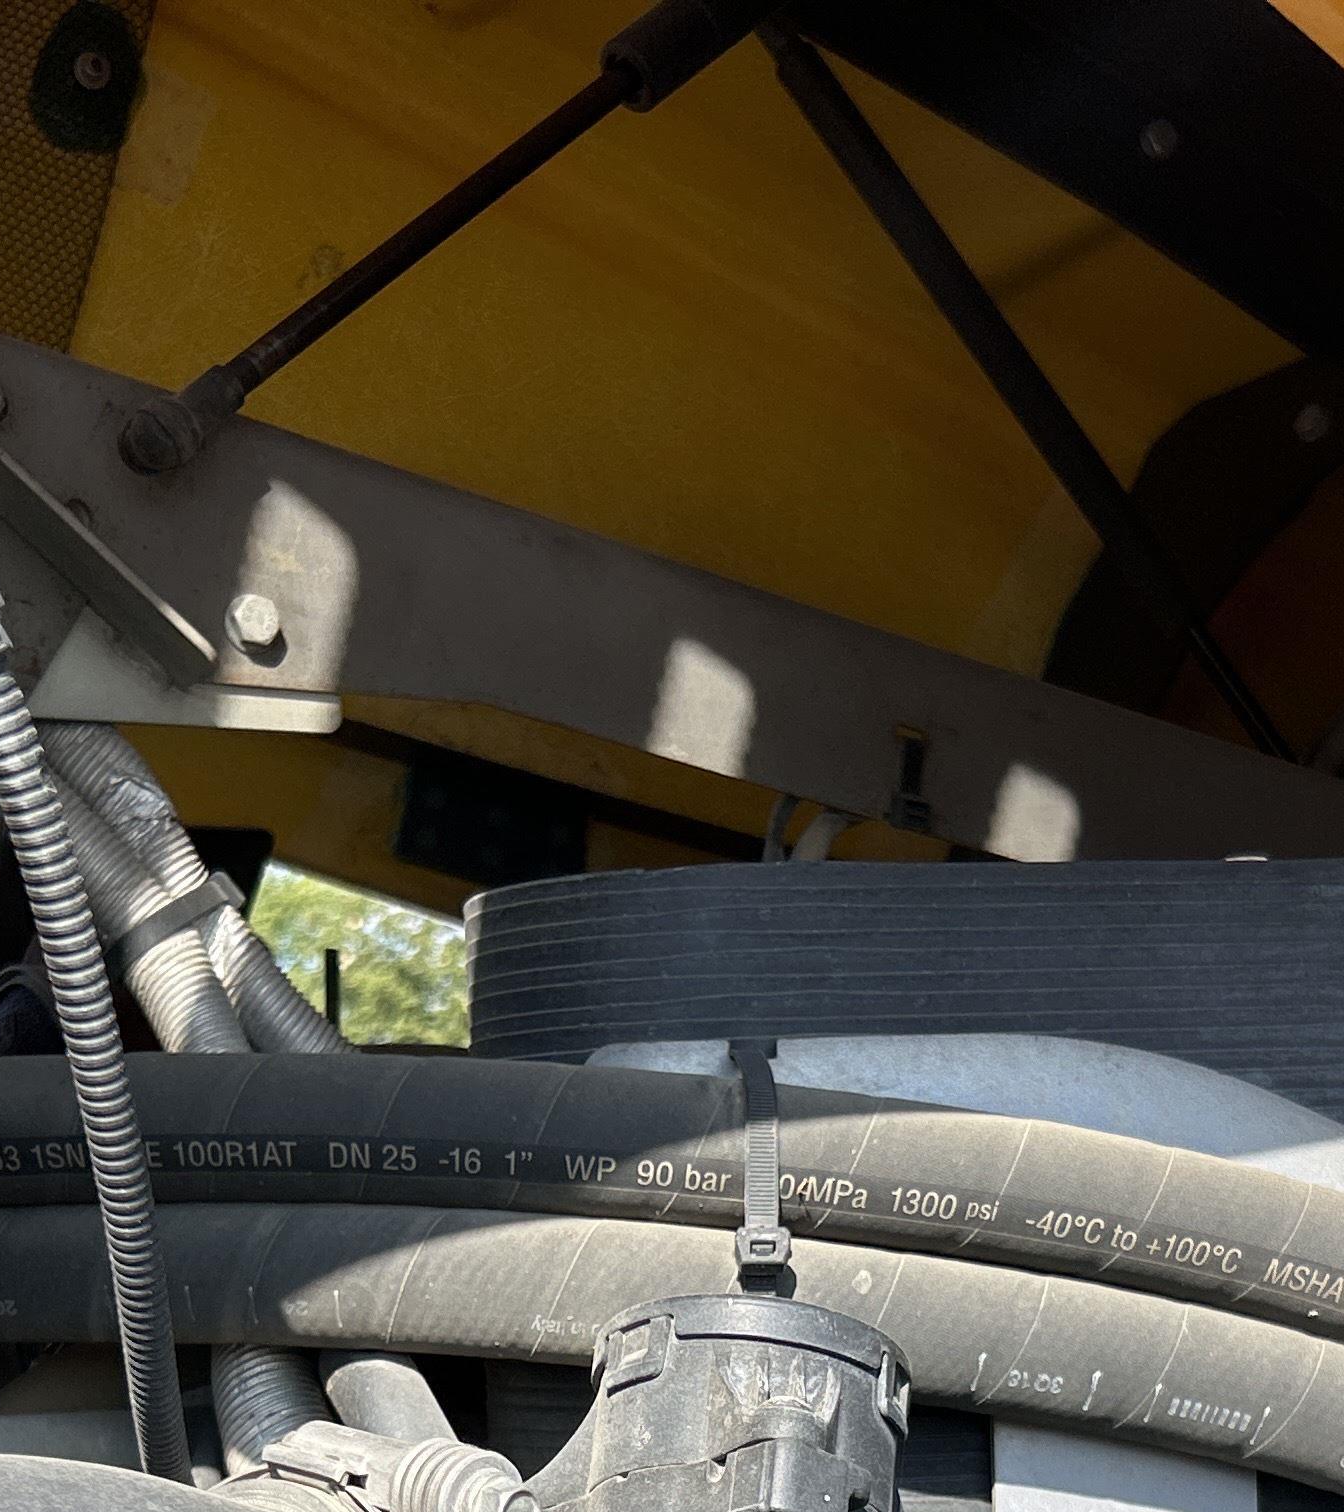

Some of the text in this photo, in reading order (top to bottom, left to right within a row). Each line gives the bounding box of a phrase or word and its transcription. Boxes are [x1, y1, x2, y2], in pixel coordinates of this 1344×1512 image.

[33, 1142, 86, 1170] 1SN
[173, 1140, 298, 1169] 100R1AT
[327, 1141, 372, 1170] DN
[381, 1143, 418, 1173] 25
[438, 1147, 483, 1176] -16
[565, 1154, 618, 1183] WP
[636, 1159, 674, 1188] 90
[684, 1162, 732, 1194] bar
[890, 1186, 958, 1221] 1300
[964, 1199, 1000, 1224] psi
[1025, 1210, 1105, 1245] -40°C
[1112, 1223, 1137, 1253] to
[1145, 1232, 1243, 1275] +100°C
[1263, 1257, 1344, 1305] MSHA
